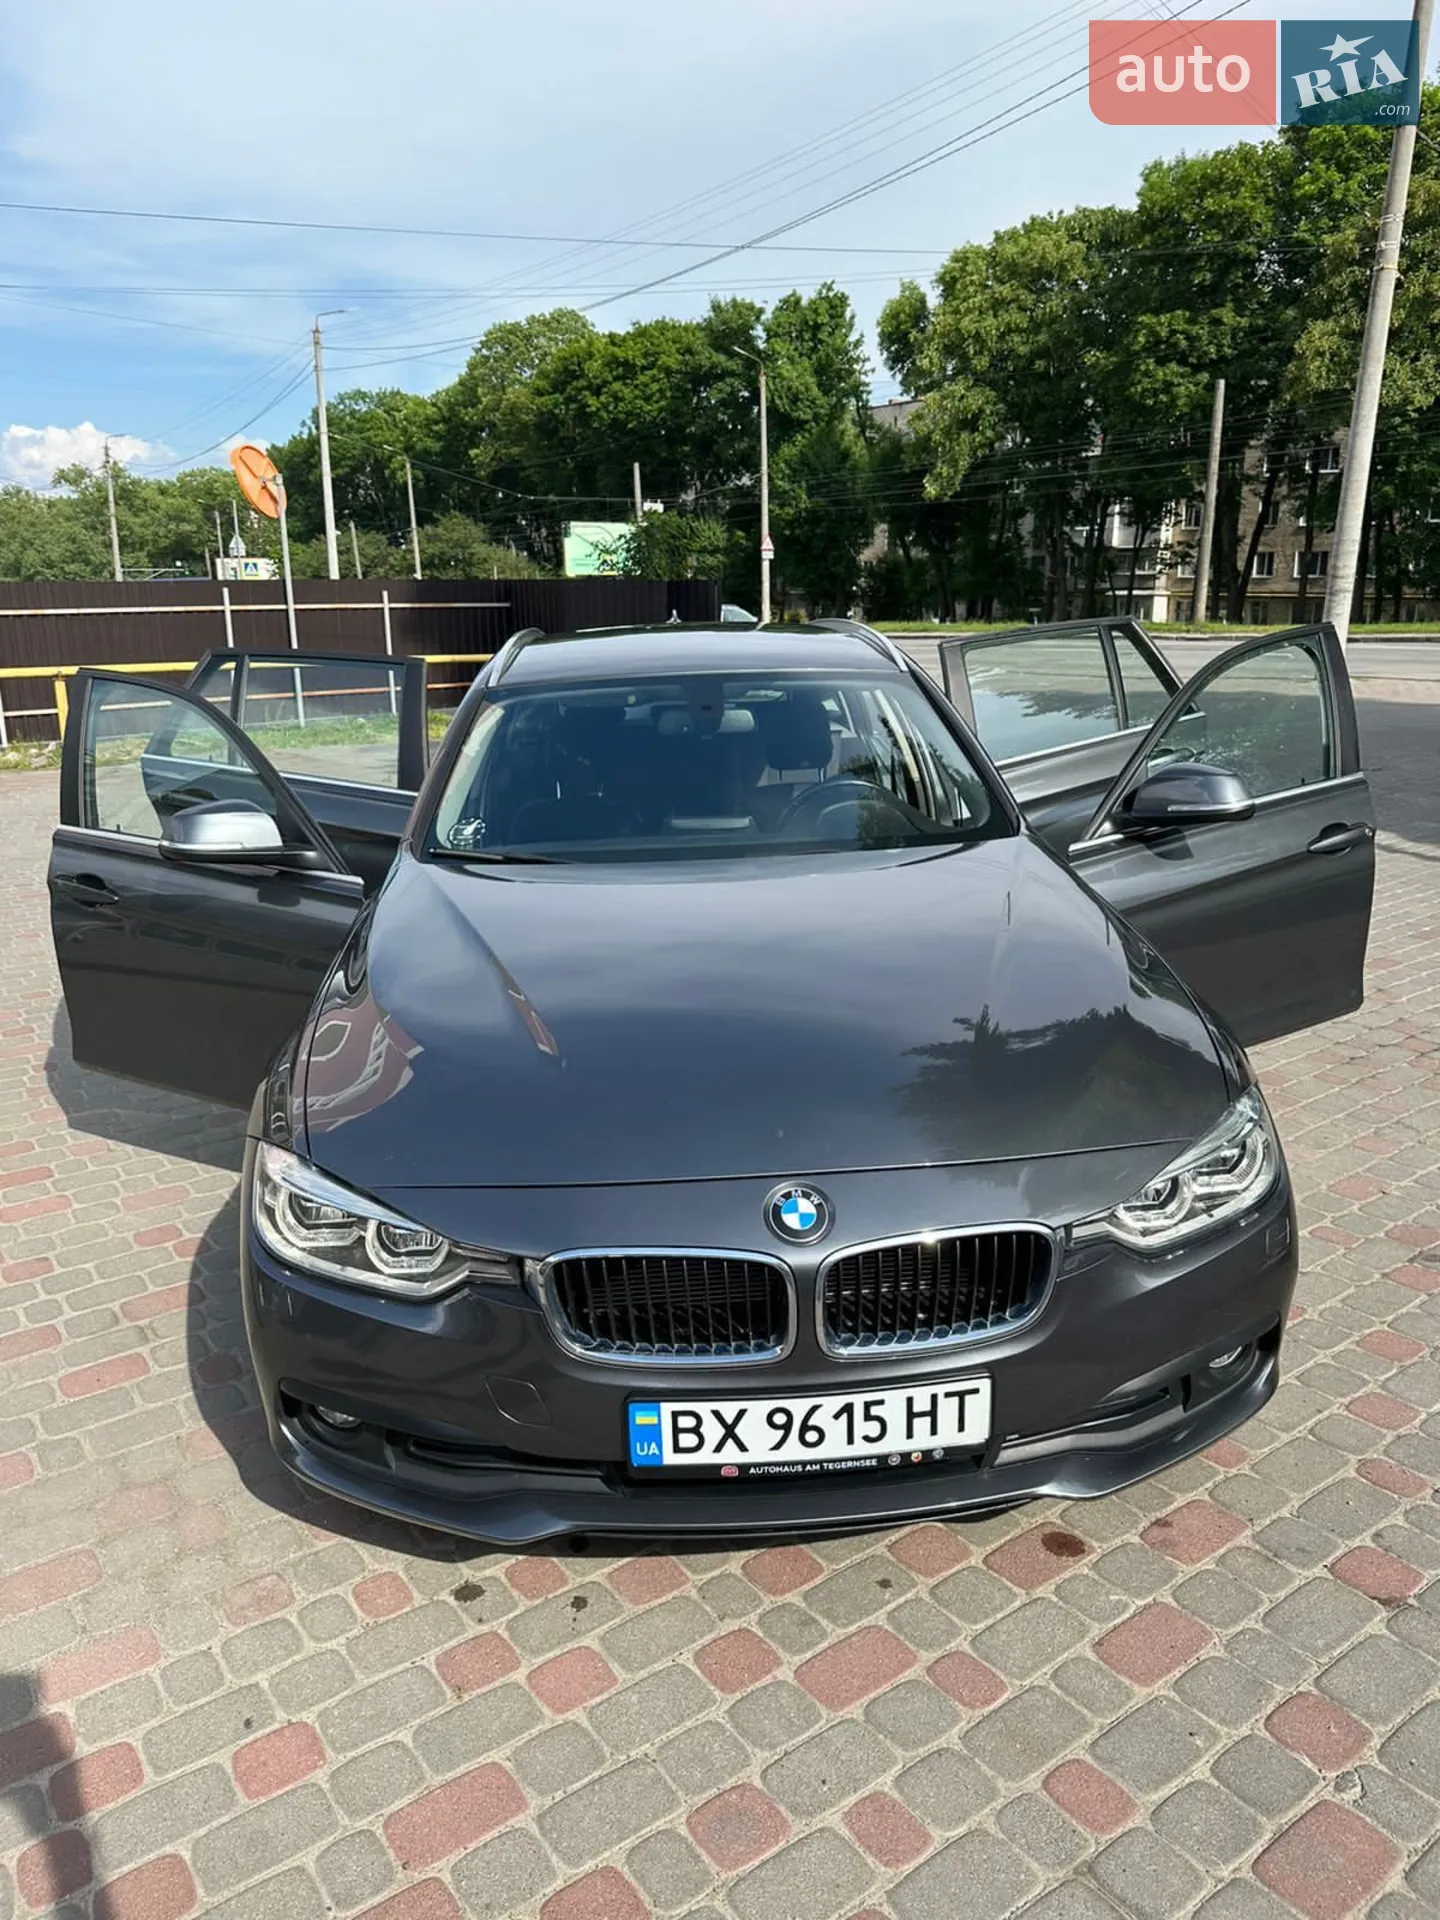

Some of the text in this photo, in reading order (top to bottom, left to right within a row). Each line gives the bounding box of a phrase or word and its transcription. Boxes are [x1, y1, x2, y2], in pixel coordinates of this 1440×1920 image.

[671, 1388, 980, 1454] BX 9615 HT
[636, 1441, 660, 1456] UA
[749, 1458, 878, 1475] AUTOHAUS AM TEGERNSEE
